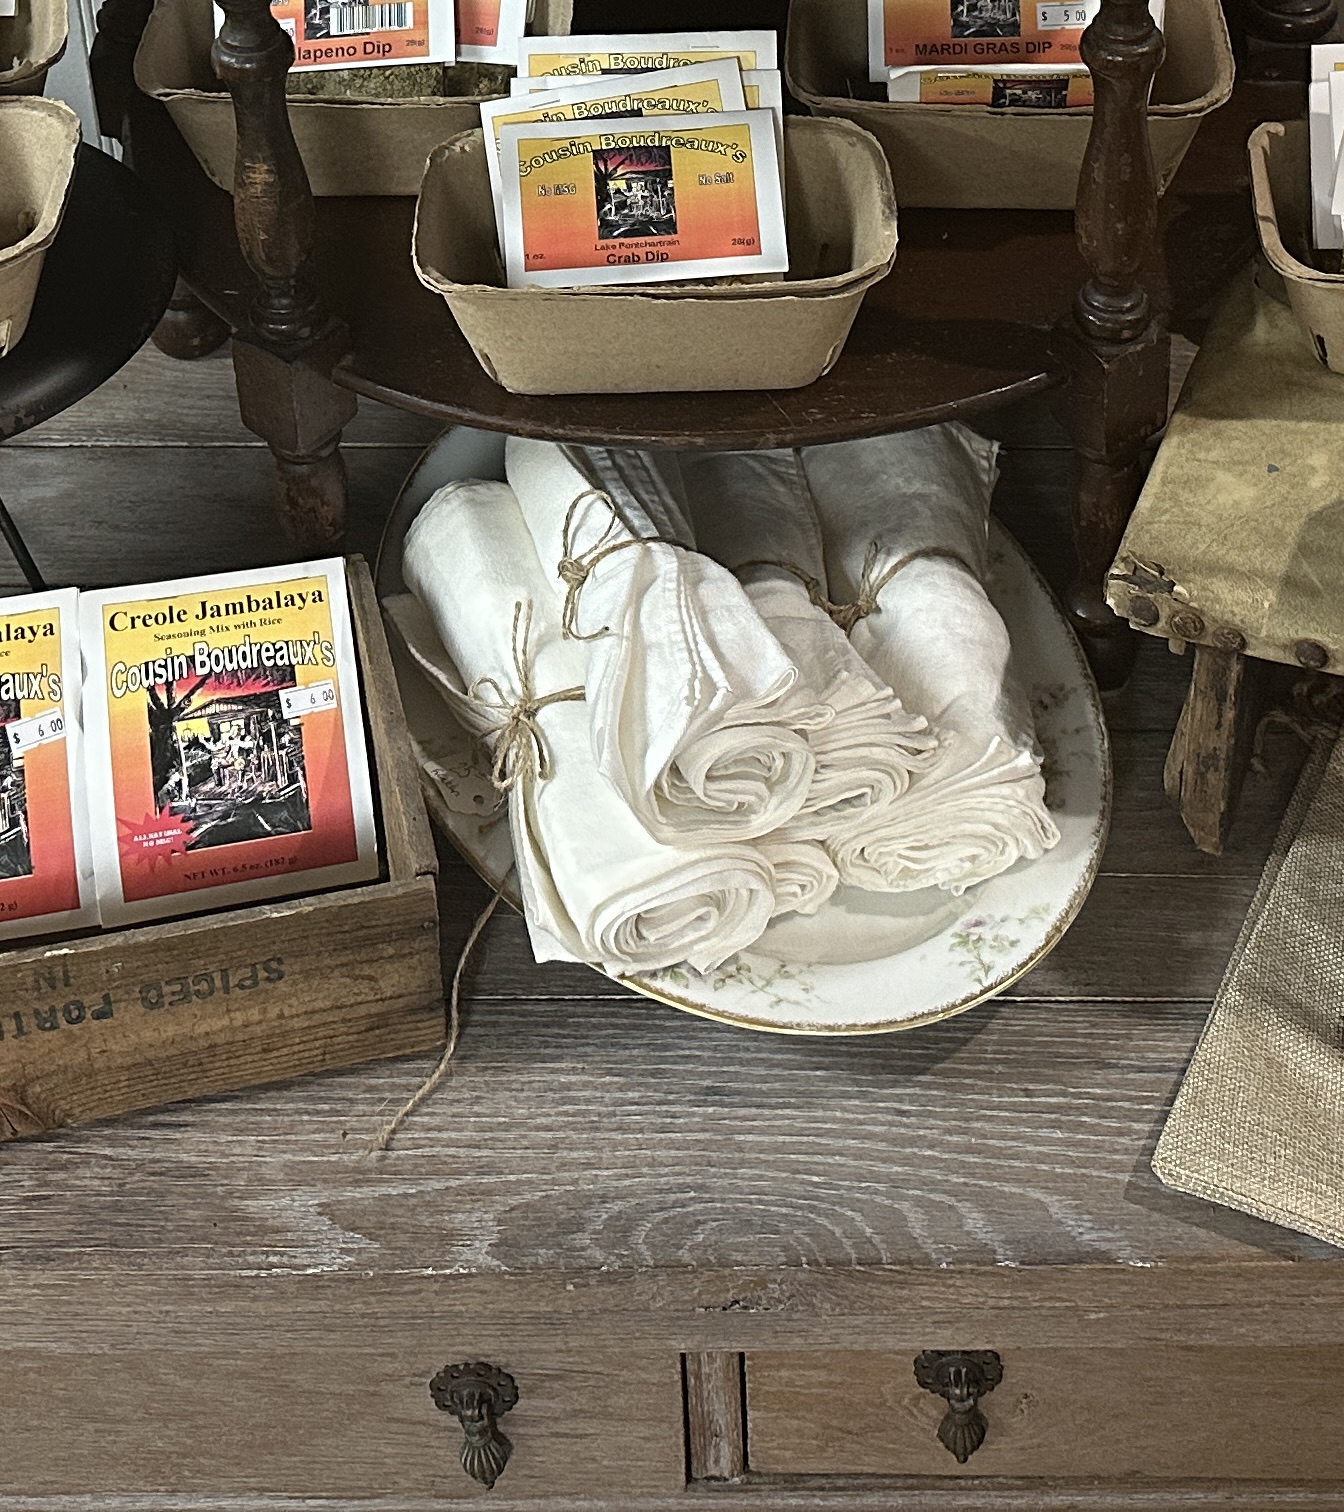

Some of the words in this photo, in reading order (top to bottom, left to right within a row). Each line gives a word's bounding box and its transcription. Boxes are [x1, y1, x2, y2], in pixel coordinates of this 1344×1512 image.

[1041, 11, 1049, 22] $
[1063, 10, 1071, 22] 5
[363, 40, 393, 57] Dip
[914, 42, 969, 57] MARDI
[973, 41, 1022, 56] GRAS
[1025, 41, 1054, 55] DIP
[519, 141, 593, 177] Cousin
[599, 132, 747, 164] Boudreaux's
[594, 243, 616, 252] Lake
[618, 238, 681, 250] Pontchartrain
[606, 251, 641, 265] Crab
[645, 250, 670, 263] Dip
[109, 606, 188, 634] Creole
[194, 586, 325, 622] Jambalaya
[153, 627, 207, 643] Seasoning
[209, 624, 231, 636] Mix
[234, 620, 257, 633] with
[259, 616, 283, 628] Rice
[111, 647, 188, 700] Cousin
[194, 630, 335, 678] Boudreaux's
[284, 696, 293, 710] $
[321, 687, 335, 703] 00
[12, 731, 21, 746] $
[48, 717, 64, 734] 00
[141, 955, 286, 1012] SPICED
